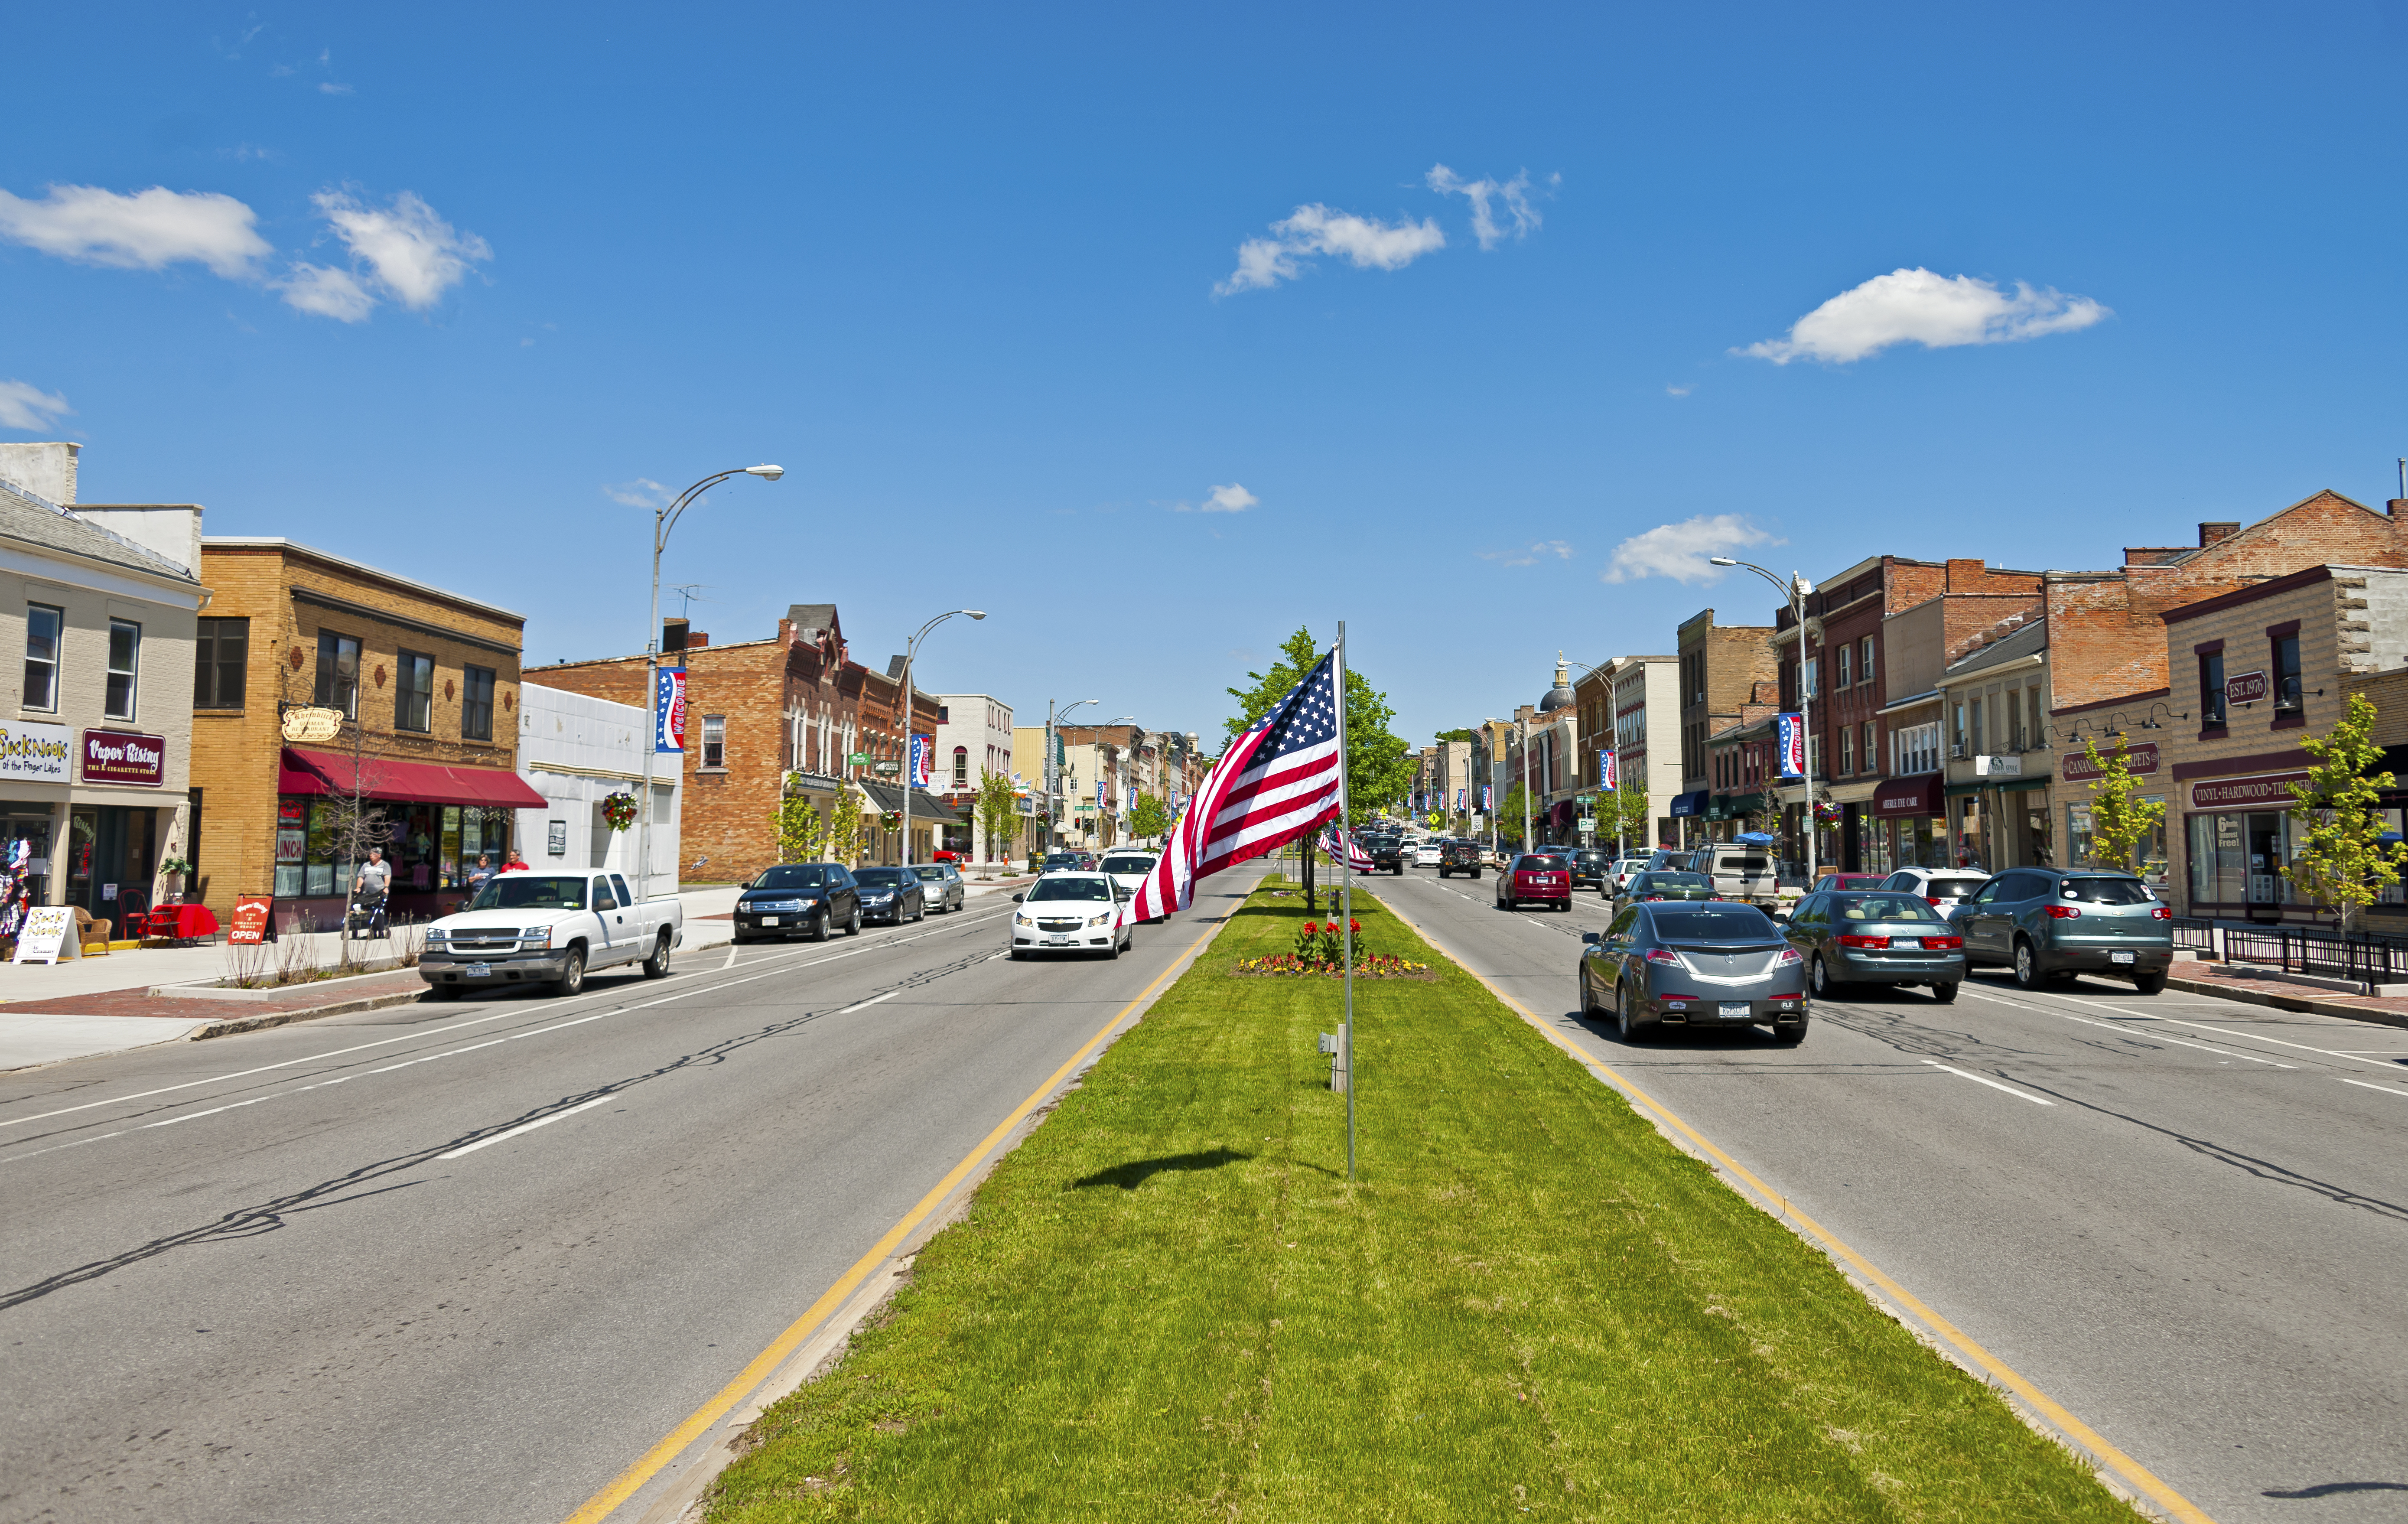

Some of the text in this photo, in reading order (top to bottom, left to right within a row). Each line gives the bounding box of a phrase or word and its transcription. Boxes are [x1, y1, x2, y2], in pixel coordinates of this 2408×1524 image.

[2229, 678, 2263, 698] EST. 1976
[674, 679, 686, 735] Welcome
[1794, 722, 1802, 763] Welcome
[89, 739, 159, 772] Vapor Rising
[3, 759, 61, 774] of the Finger Lakes
[2006, 765, 2018, 773] STYLE
[2195, 788, 2218, 801] VINYL
[2222, 784, 2268, 799] HARDWOOD
[1882, 799, 1897, 809] ABERLE
[1907, 797, 1917, 807] CARE
[74, 815, 94, 842] Rising
[1581, 821, 1587, 829] P
[2218, 817, 2226, 832] 6
[277, 840, 302, 858] UNCH
[2219, 838, 2239, 847] Free!
[231, 930, 260, 940] OPEN
